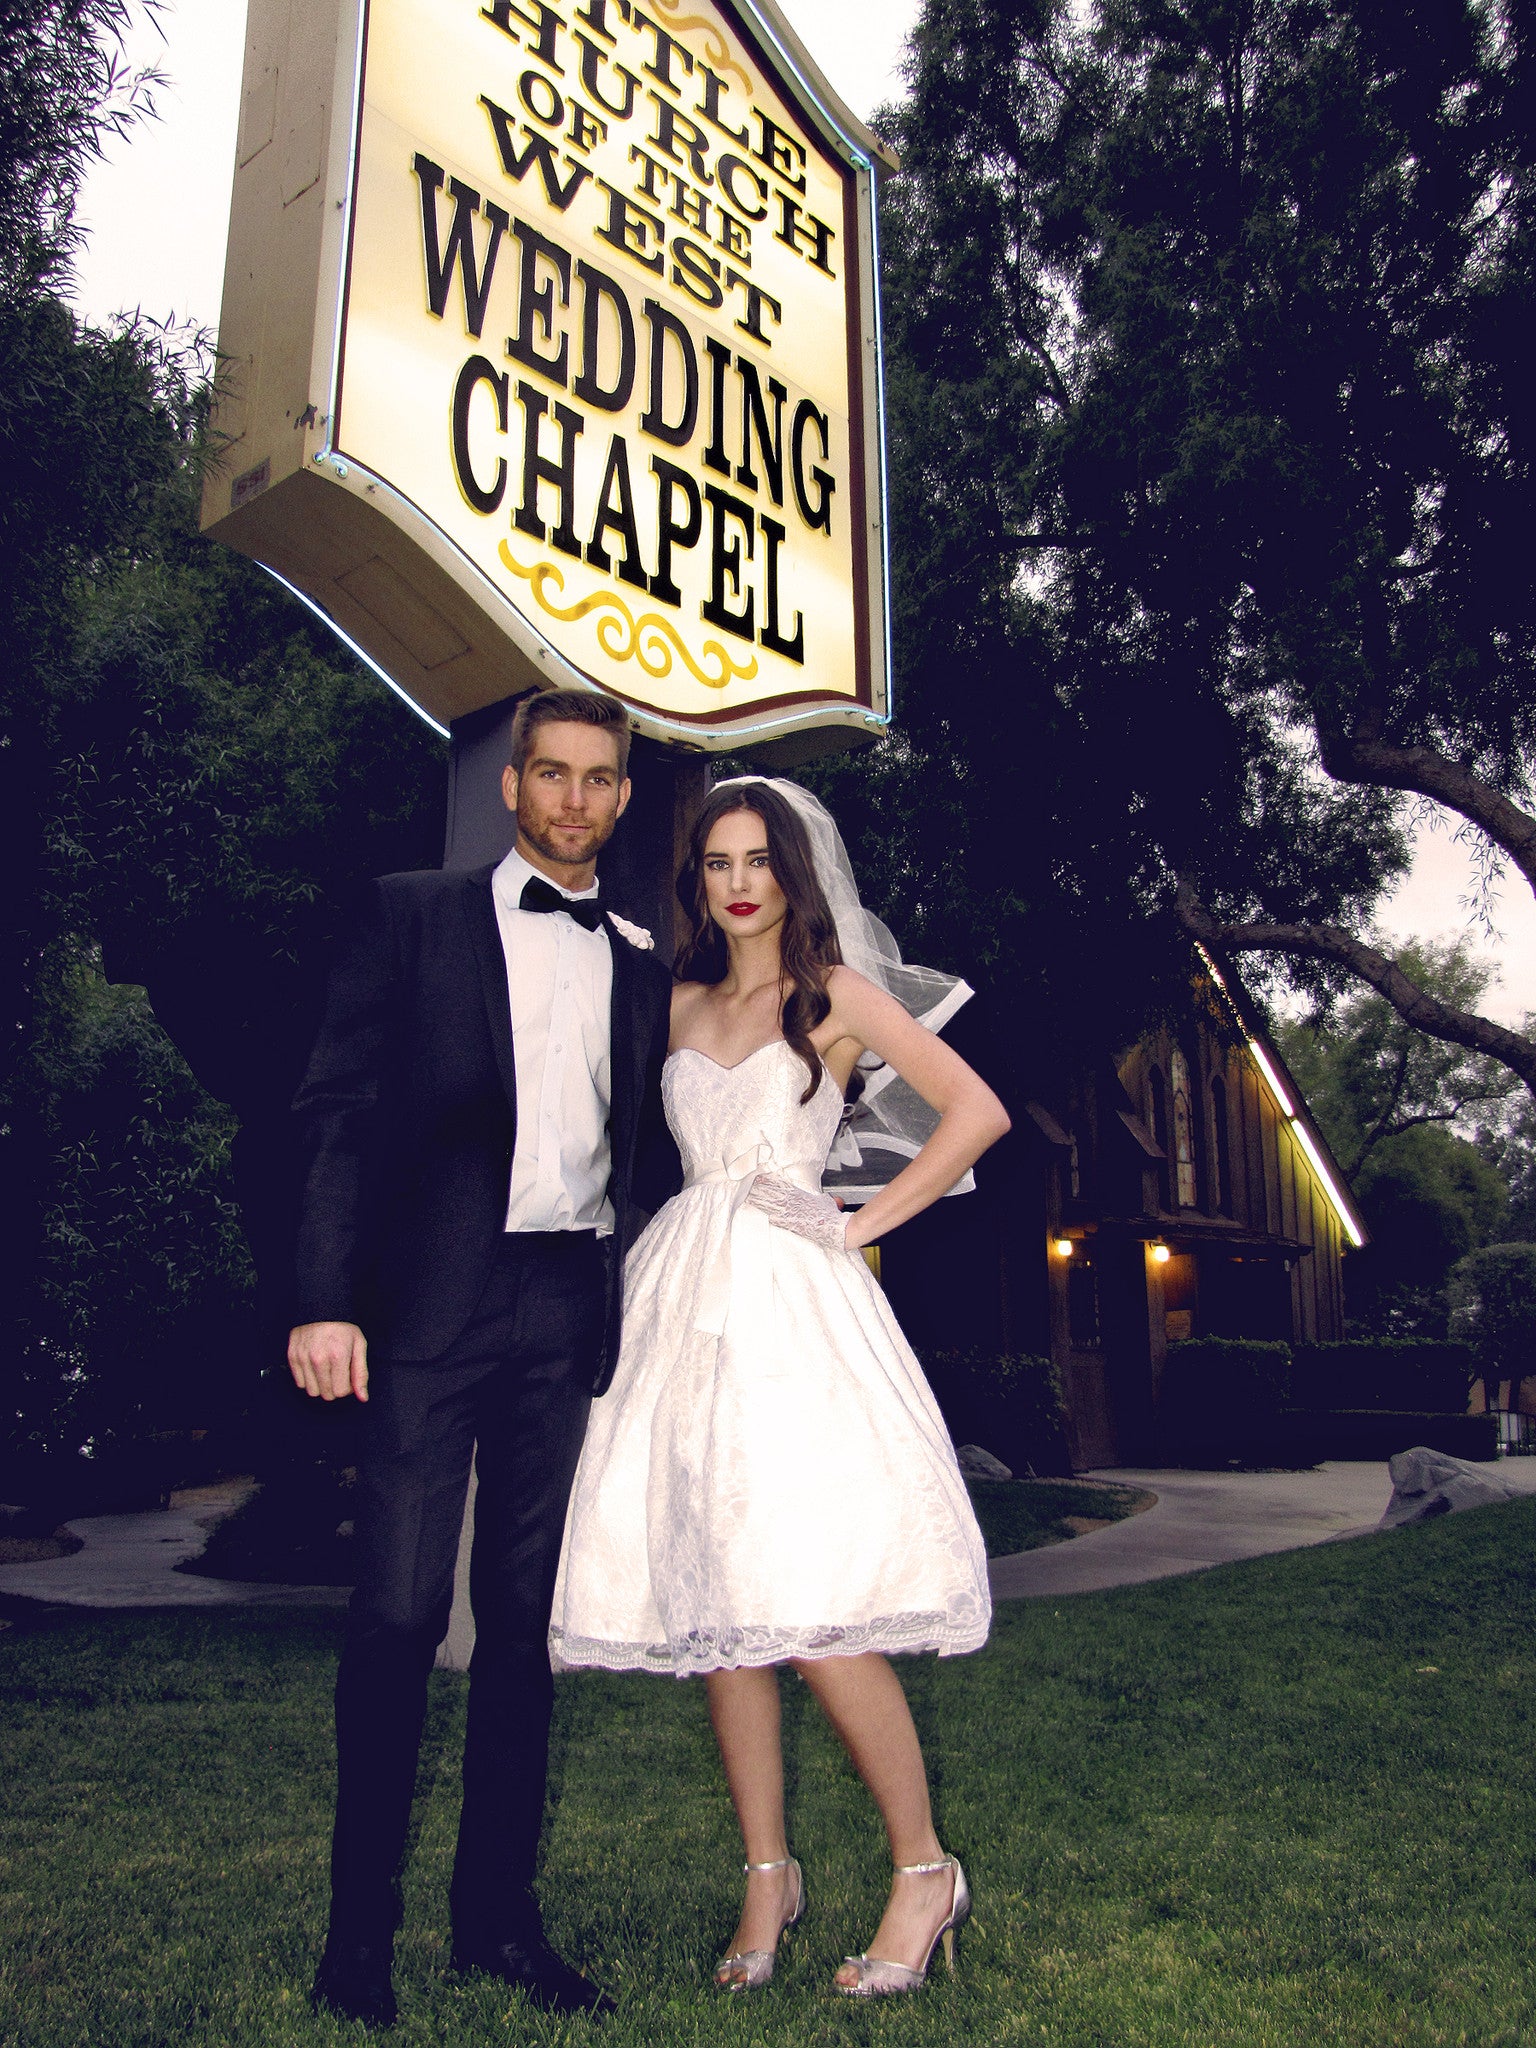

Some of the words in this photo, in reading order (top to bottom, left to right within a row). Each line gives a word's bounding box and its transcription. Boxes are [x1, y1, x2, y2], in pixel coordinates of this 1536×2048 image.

[478, 94, 782, 348] WEST
[479, 0, 836, 280] HURCH
[517, 70, 608, 155] OF
[629, 144, 752, 269] THE
[574, 0, 807, 198] TTLE
[411, 151, 836, 538] WEDDING
[450, 354, 805, 666] CHAPEL
